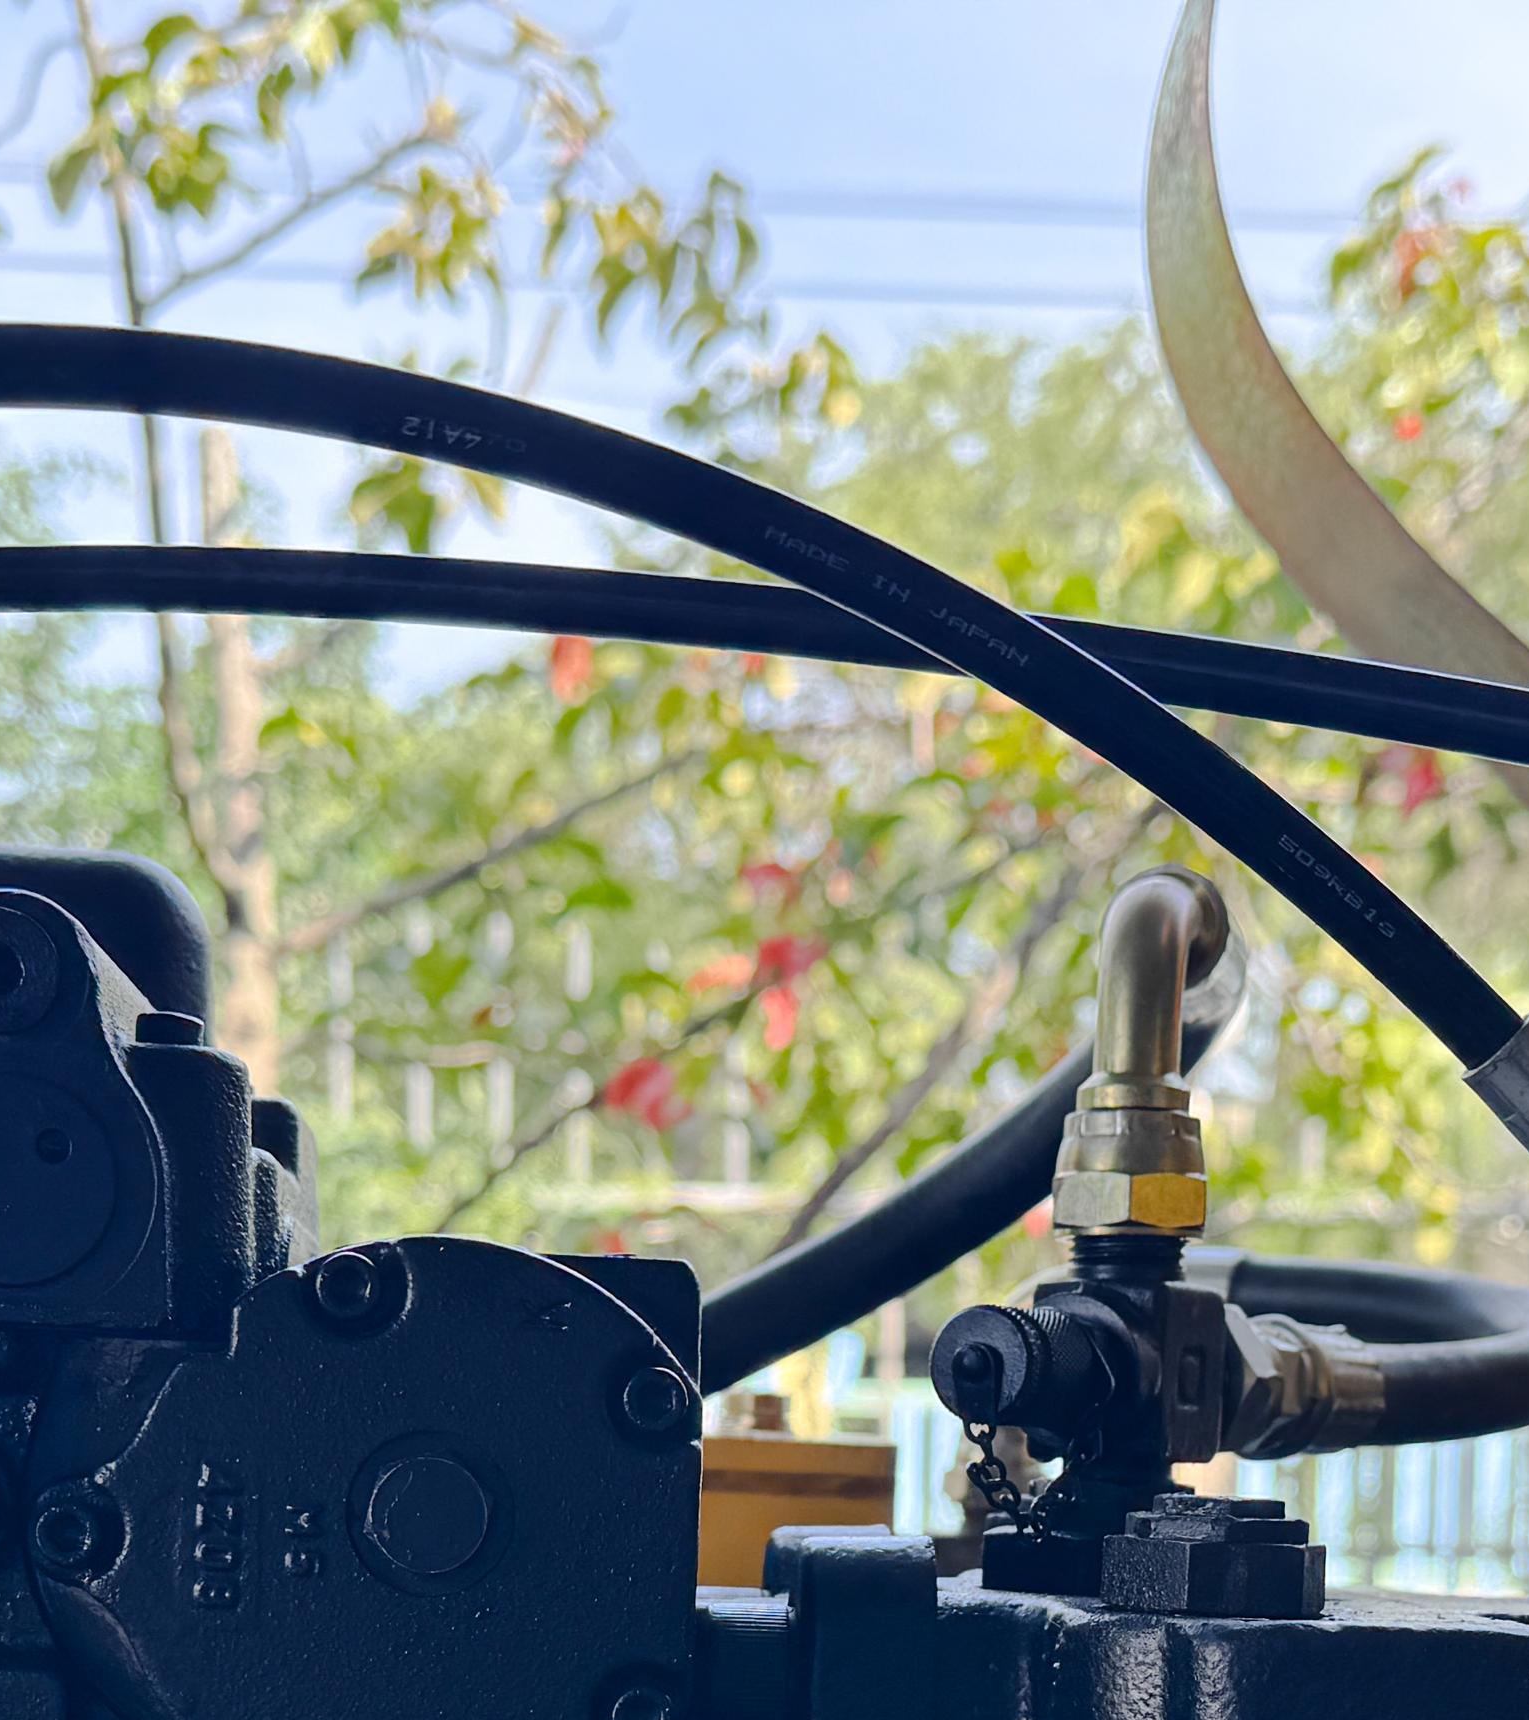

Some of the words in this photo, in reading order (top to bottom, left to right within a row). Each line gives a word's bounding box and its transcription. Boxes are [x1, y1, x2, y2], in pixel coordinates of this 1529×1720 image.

[763, 523, 851, 572] MADE
[871, 575, 912, 604] IN
[928, 605, 1033, 668] JAPAN
